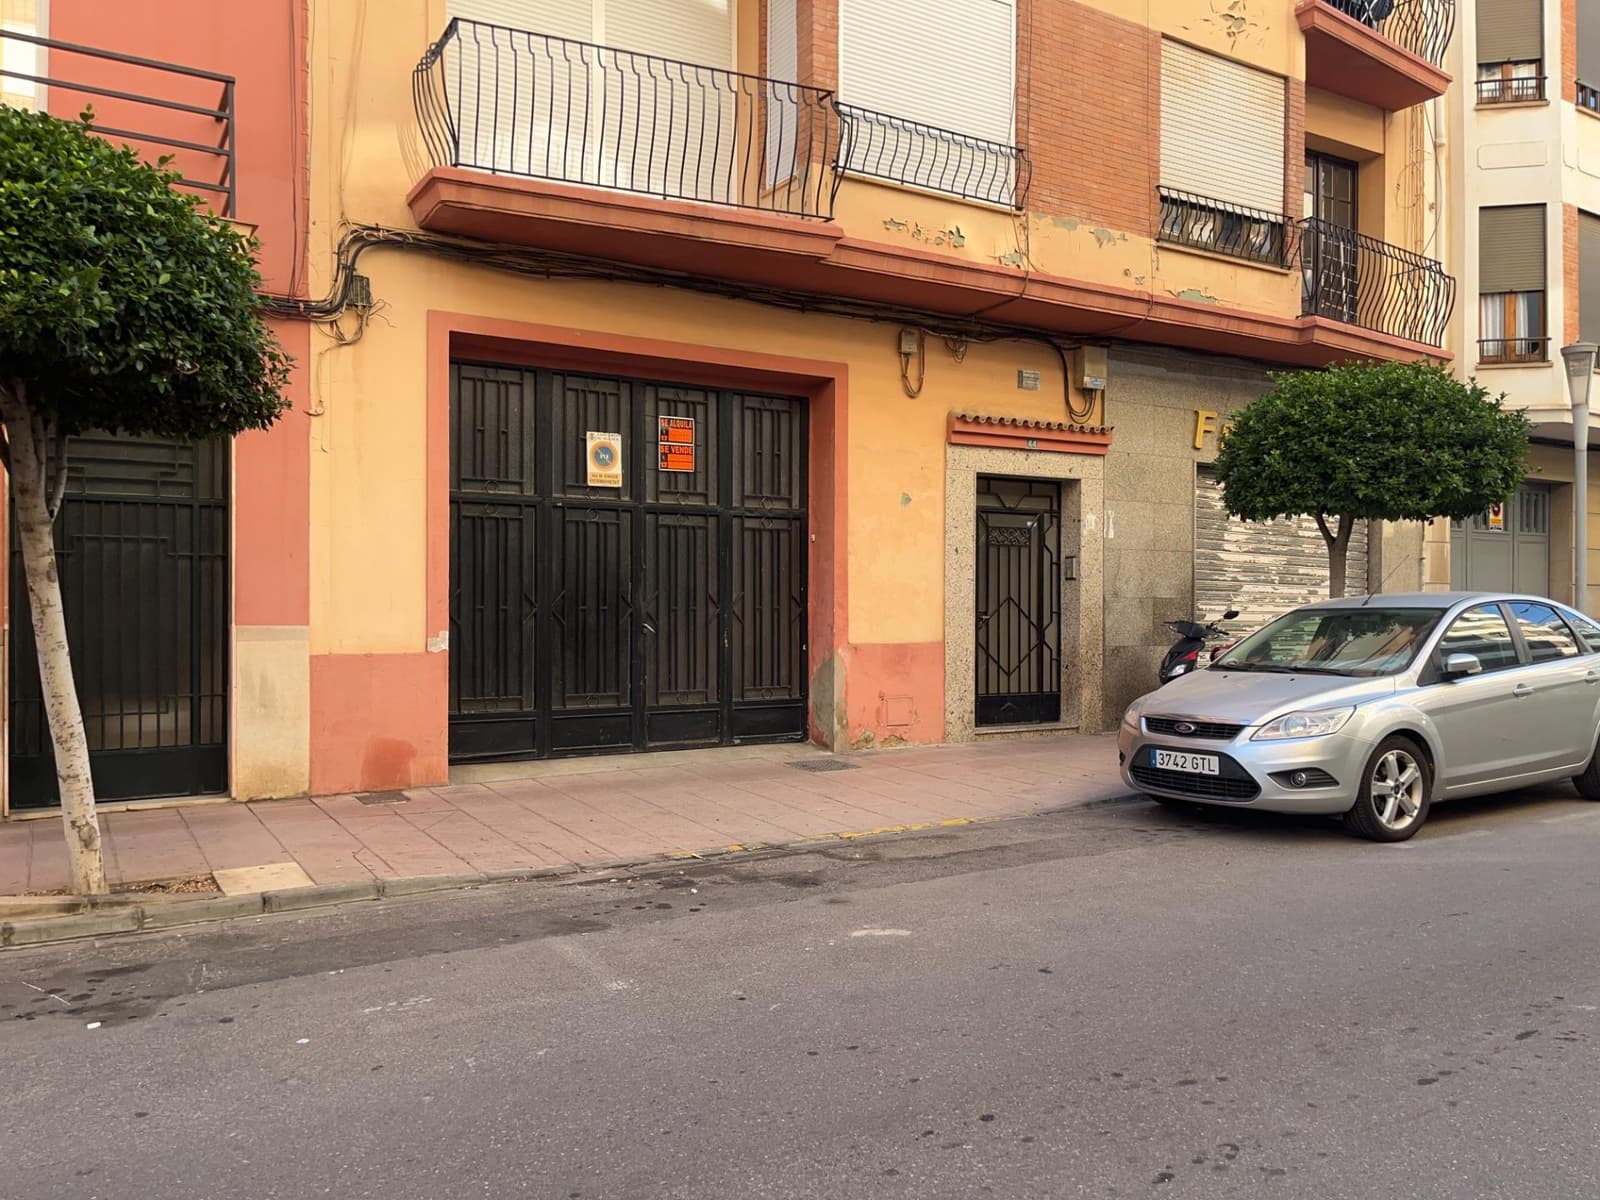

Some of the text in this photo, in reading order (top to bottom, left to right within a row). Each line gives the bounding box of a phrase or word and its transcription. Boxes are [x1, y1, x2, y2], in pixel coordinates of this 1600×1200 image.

[660, 418, 692, 429] SE ALQUILA
[660, 445, 693, 455] SE VENDE
[1158, 753, 1216, 772] 3742 GTL
